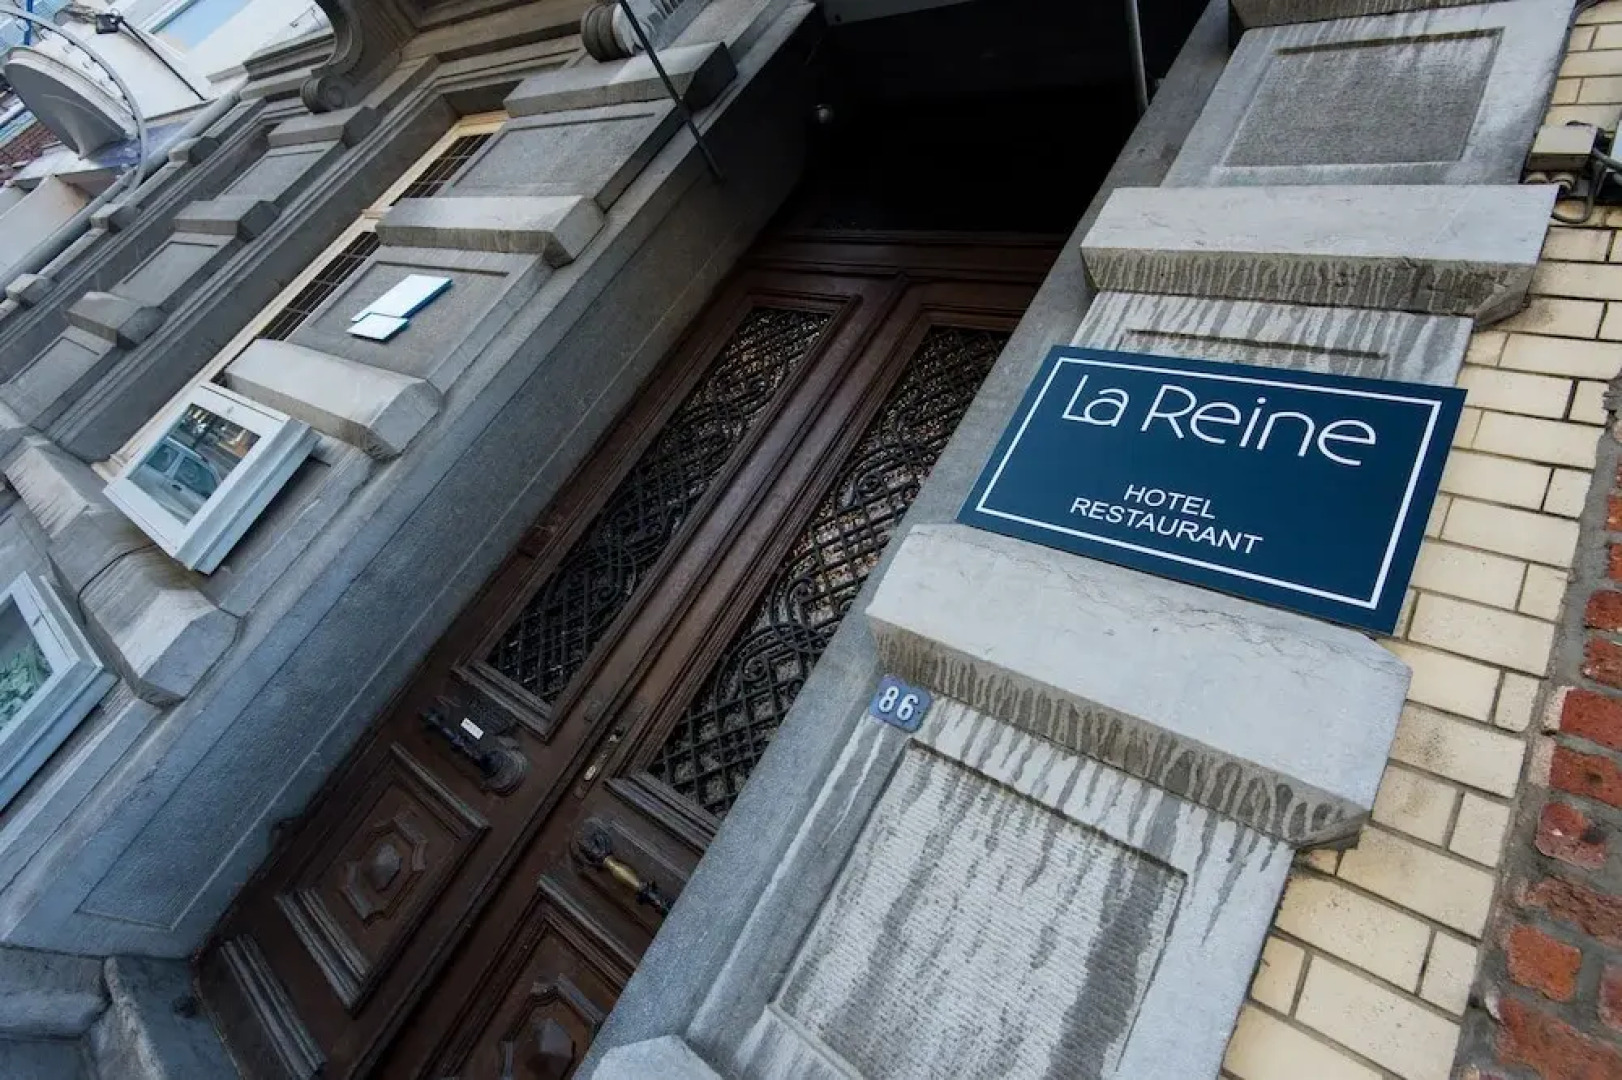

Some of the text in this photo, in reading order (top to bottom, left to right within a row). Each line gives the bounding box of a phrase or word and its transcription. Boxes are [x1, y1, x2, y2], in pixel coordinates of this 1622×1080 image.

[1060, 373, 1377, 466] La Reine
[1069, 496, 1263, 555] RESTAURANT
[1123, 483, 1216, 520] HOTEL
[878, 685, 919, 721] 86
